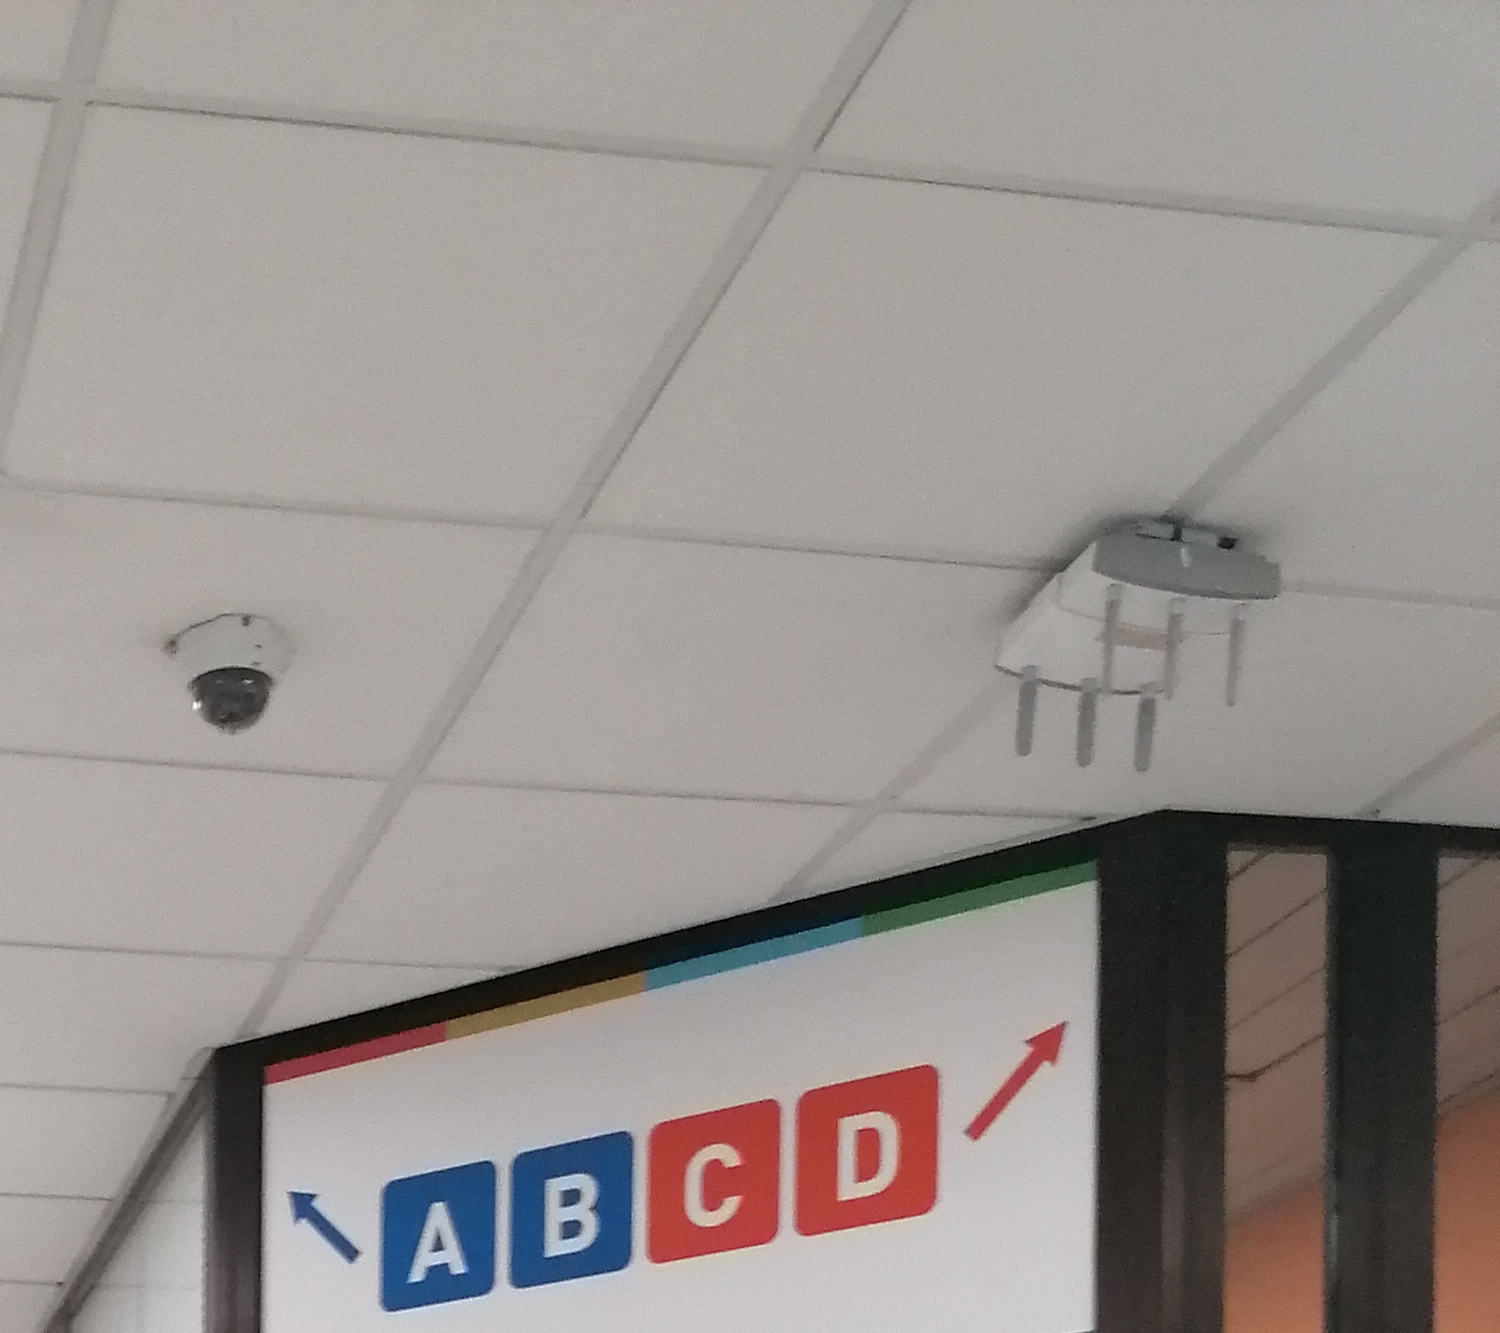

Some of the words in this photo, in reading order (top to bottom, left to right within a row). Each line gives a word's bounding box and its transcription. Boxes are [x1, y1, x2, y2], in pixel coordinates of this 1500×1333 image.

[406, 1201, 470, 1283] A
[543, 1172, 601, 1259] B
[684, 1142, 746, 1228] C
[835, 1109, 899, 1202] D
